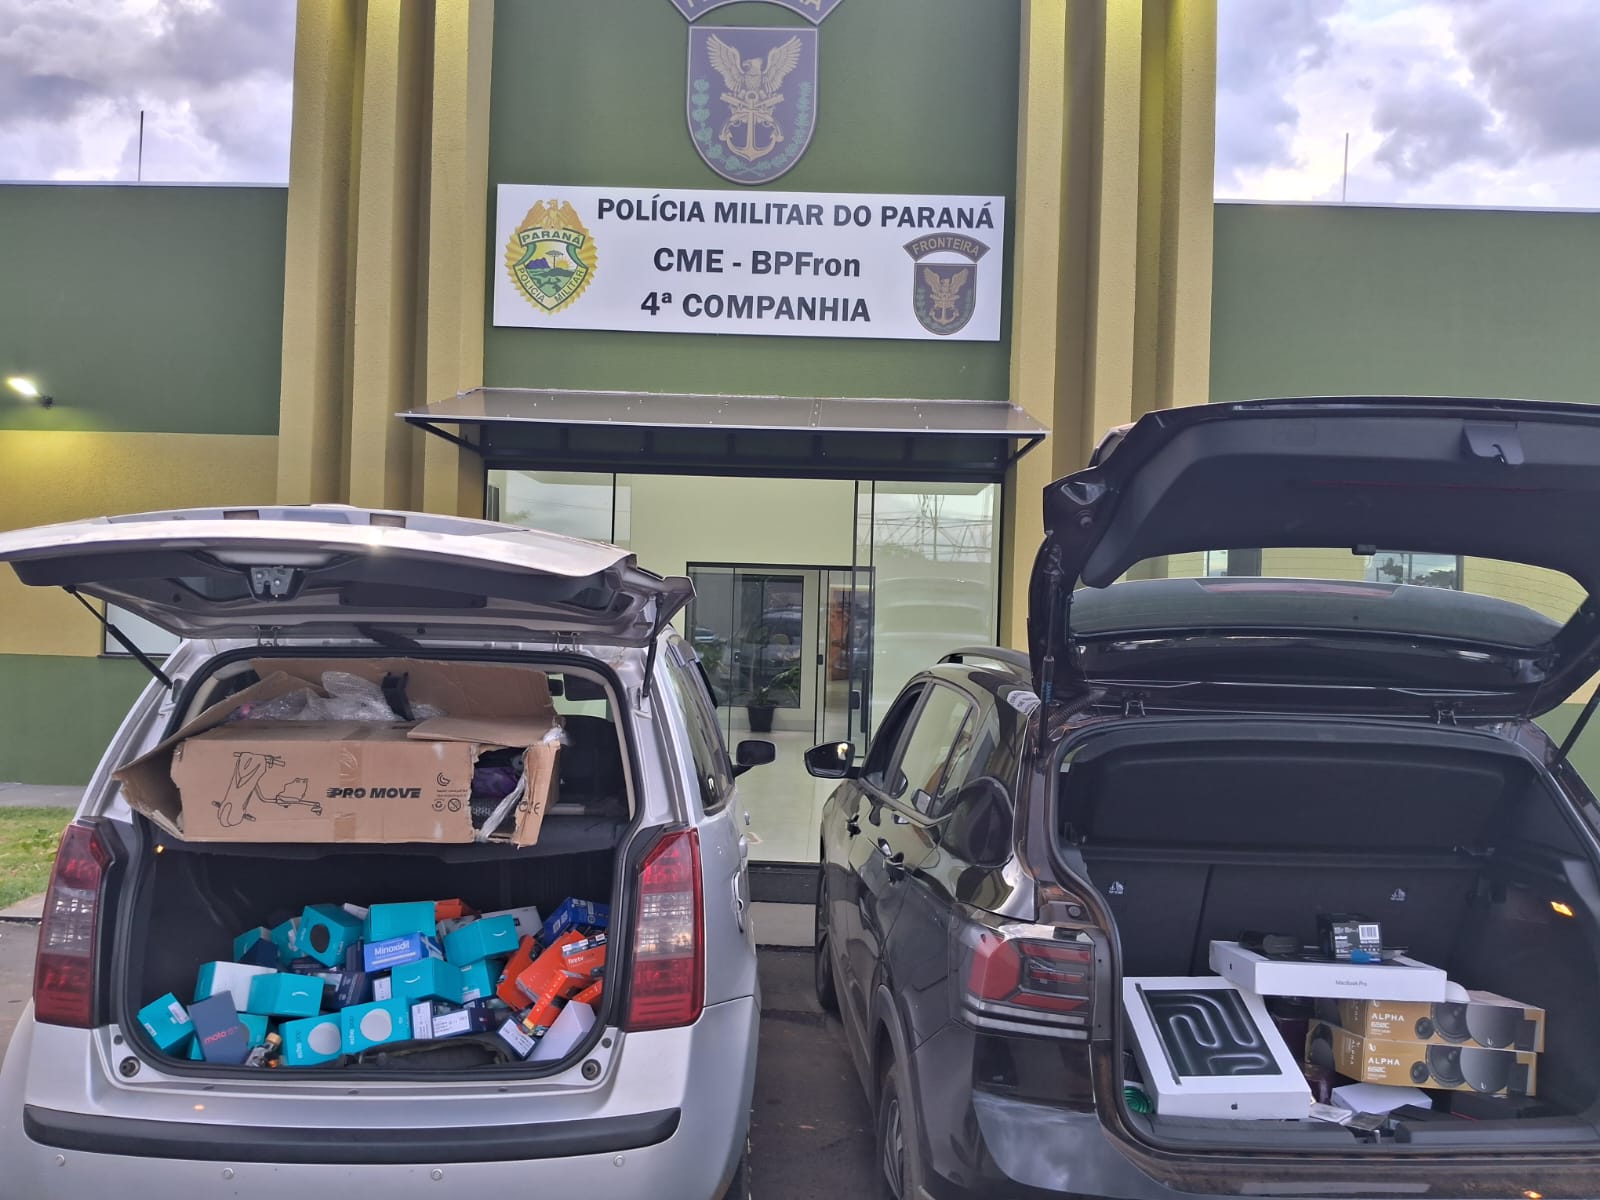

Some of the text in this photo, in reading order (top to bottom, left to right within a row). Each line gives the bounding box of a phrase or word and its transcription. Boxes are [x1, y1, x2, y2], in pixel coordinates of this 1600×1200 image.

[597, 193, 994, 229] POLÍCIA MILITAR DO PARANÁ
[521, 230, 580, 245] PARANÁ
[912, 236, 980, 257] FRONTEIRA
[653, 247, 724, 273] CME
[751, 250, 861, 277] BPFron
[554, 268, 584, 302] MILITAR
[682, 293, 871, 322] COMPANHIA
[326, 787, 422, 799] PRO MOVE
[374, 940, 410, 956] Minoxidil
[1371, 1012, 1405, 1022] ALPHA
[1367, 1057, 1400, 1066] ALPHA
